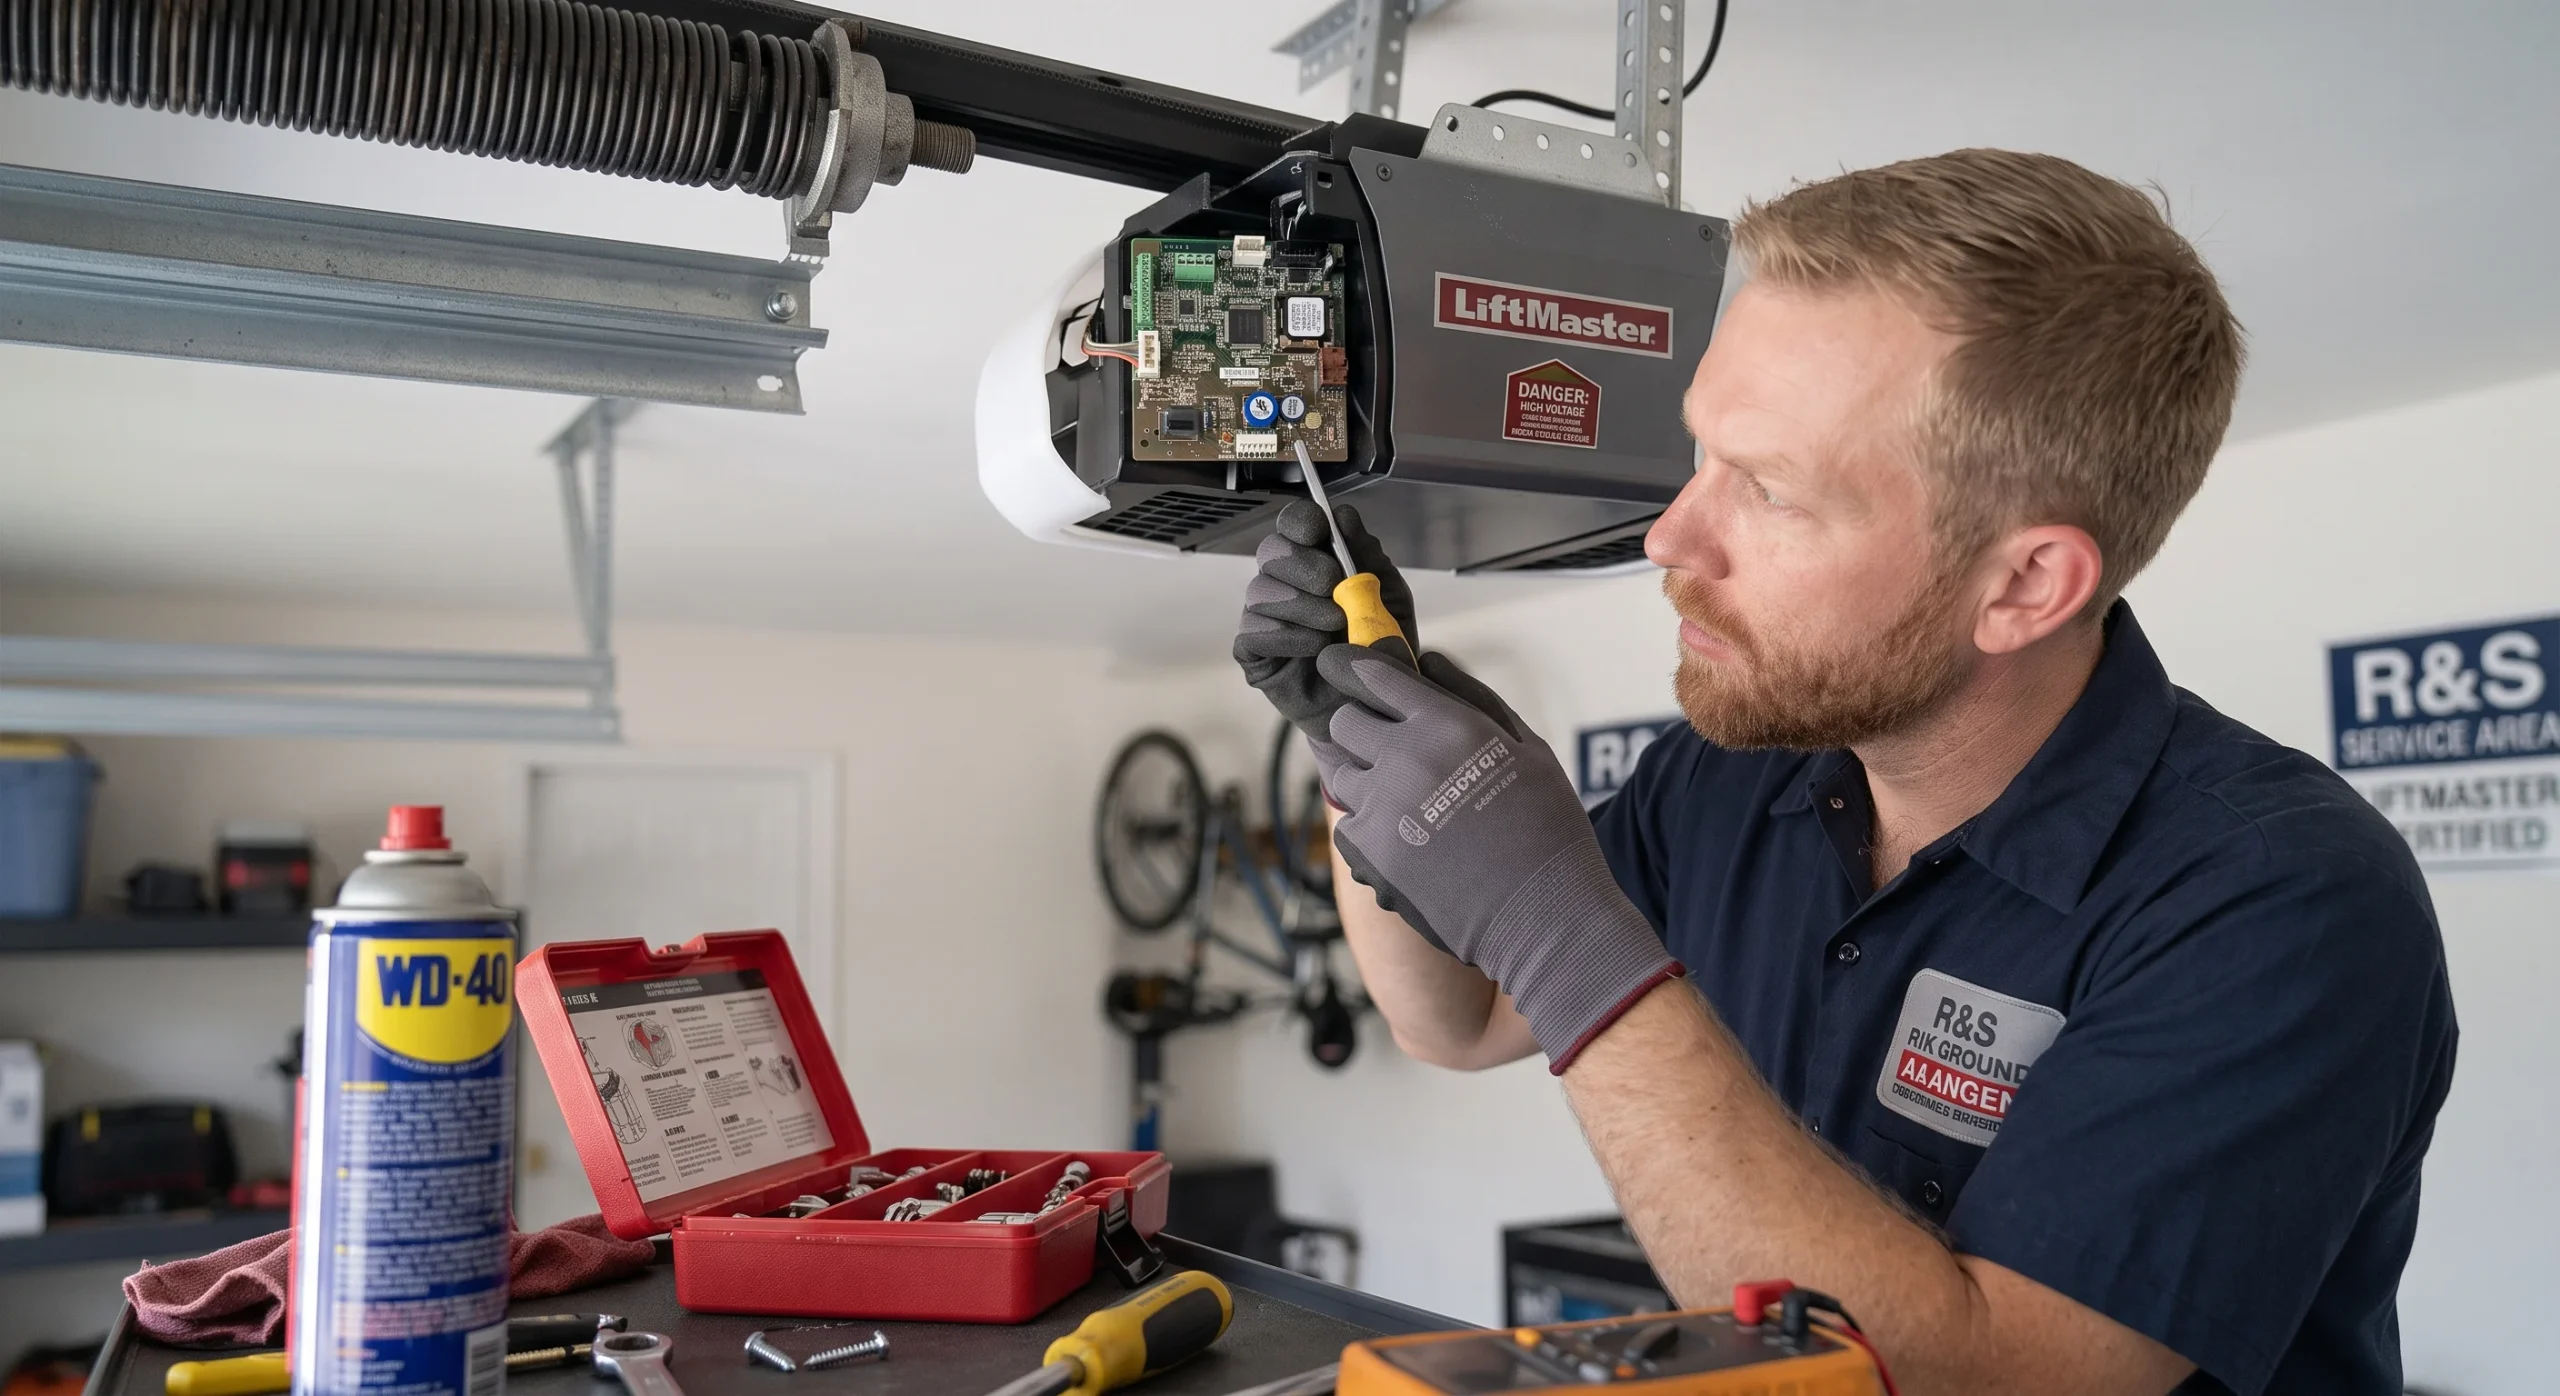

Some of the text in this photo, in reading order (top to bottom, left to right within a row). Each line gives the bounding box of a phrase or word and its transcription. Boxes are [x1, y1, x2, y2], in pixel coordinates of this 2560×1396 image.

[1455, 287, 1655, 345] LiftMaster
[1518, 381, 1589, 405] DANGER:
[1520, 400, 1586, 418] HIGH VOLTAGE
[2353, 630, 2547, 723] R&S
[2340, 719, 2470, 766] SERVICE
[2369, 772, 2560, 811] IFTMASTER
[376, 953, 507, 1008] WD-40
[1933, 996, 1998, 1048] R&S
[1907, 1027, 2031, 1084] RIK GROUND
